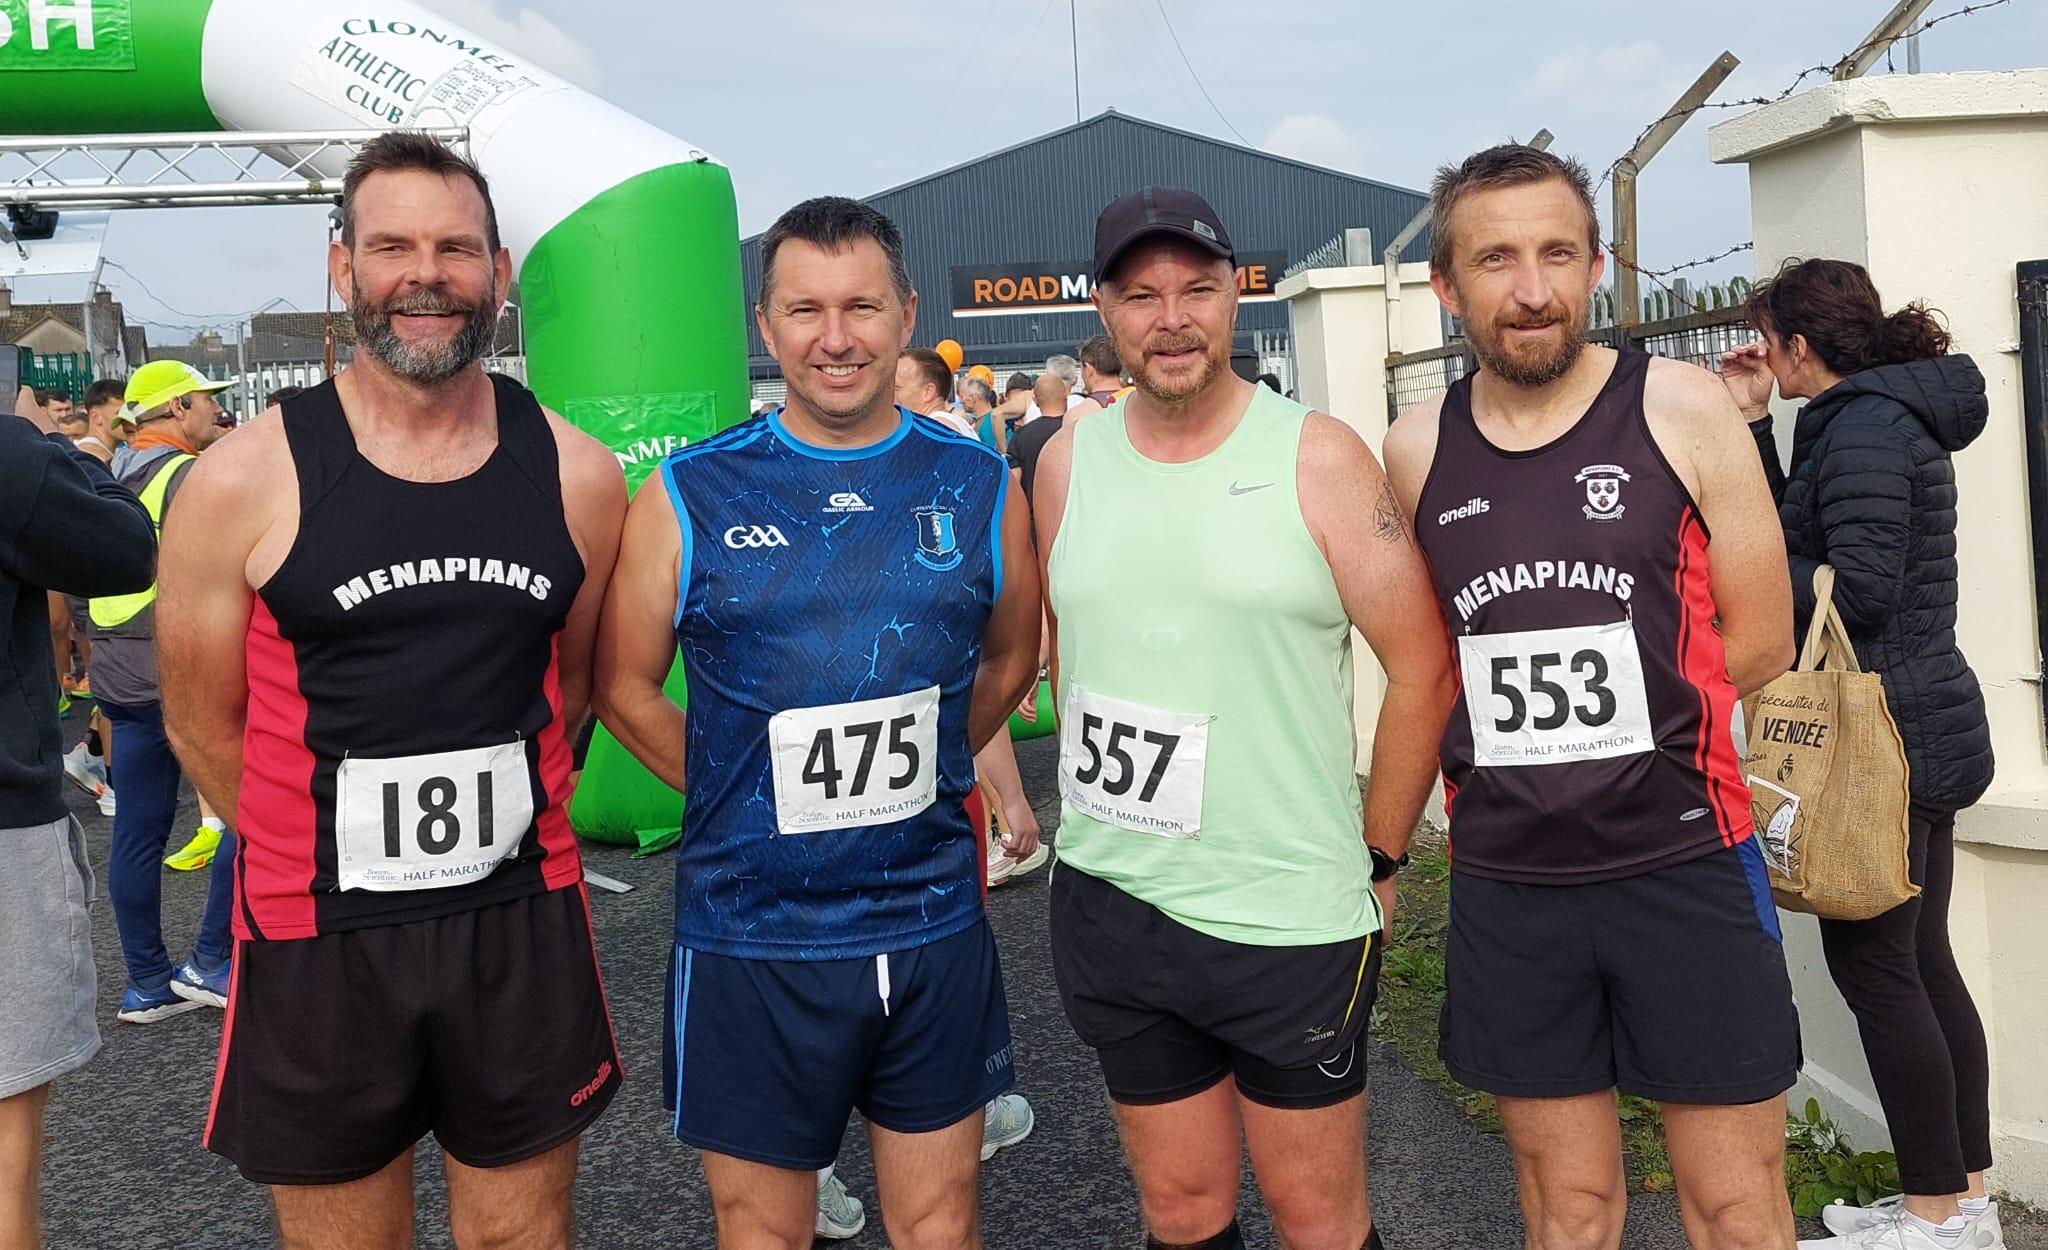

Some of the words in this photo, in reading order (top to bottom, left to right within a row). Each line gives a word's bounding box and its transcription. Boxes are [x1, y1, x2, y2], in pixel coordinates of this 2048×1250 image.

[319, 36, 426, 102] ATHLETIC
[342, 19, 515, 73] CLONMEL
[345, 84, 404, 125] CLUB
[723, 525, 790, 549] GAA
[332, 557, 552, 611] MENAPIANS
[1453, 560, 1635, 622] MENAPIANS
[1491, 648, 1617, 733] 553
[802, 712, 920, 800] 475
[1525, 744, 1554, 756] HALF
[1558, 735, 1634, 754] MARATHON
[1762, 717, 1828, 749] VENDÉE
[1075, 711, 1181, 803] 557
[382, 770, 494, 858] 181
[836, 809, 865, 821] HALF
[869, 792, 930, 817] MARATHON
[1091, 801, 1113, 816] HALF
[1116, 810, 1184, 831] MARATHON
[403, 869, 436, 882] HALF
[182, 965, 204, 985] HOKA
